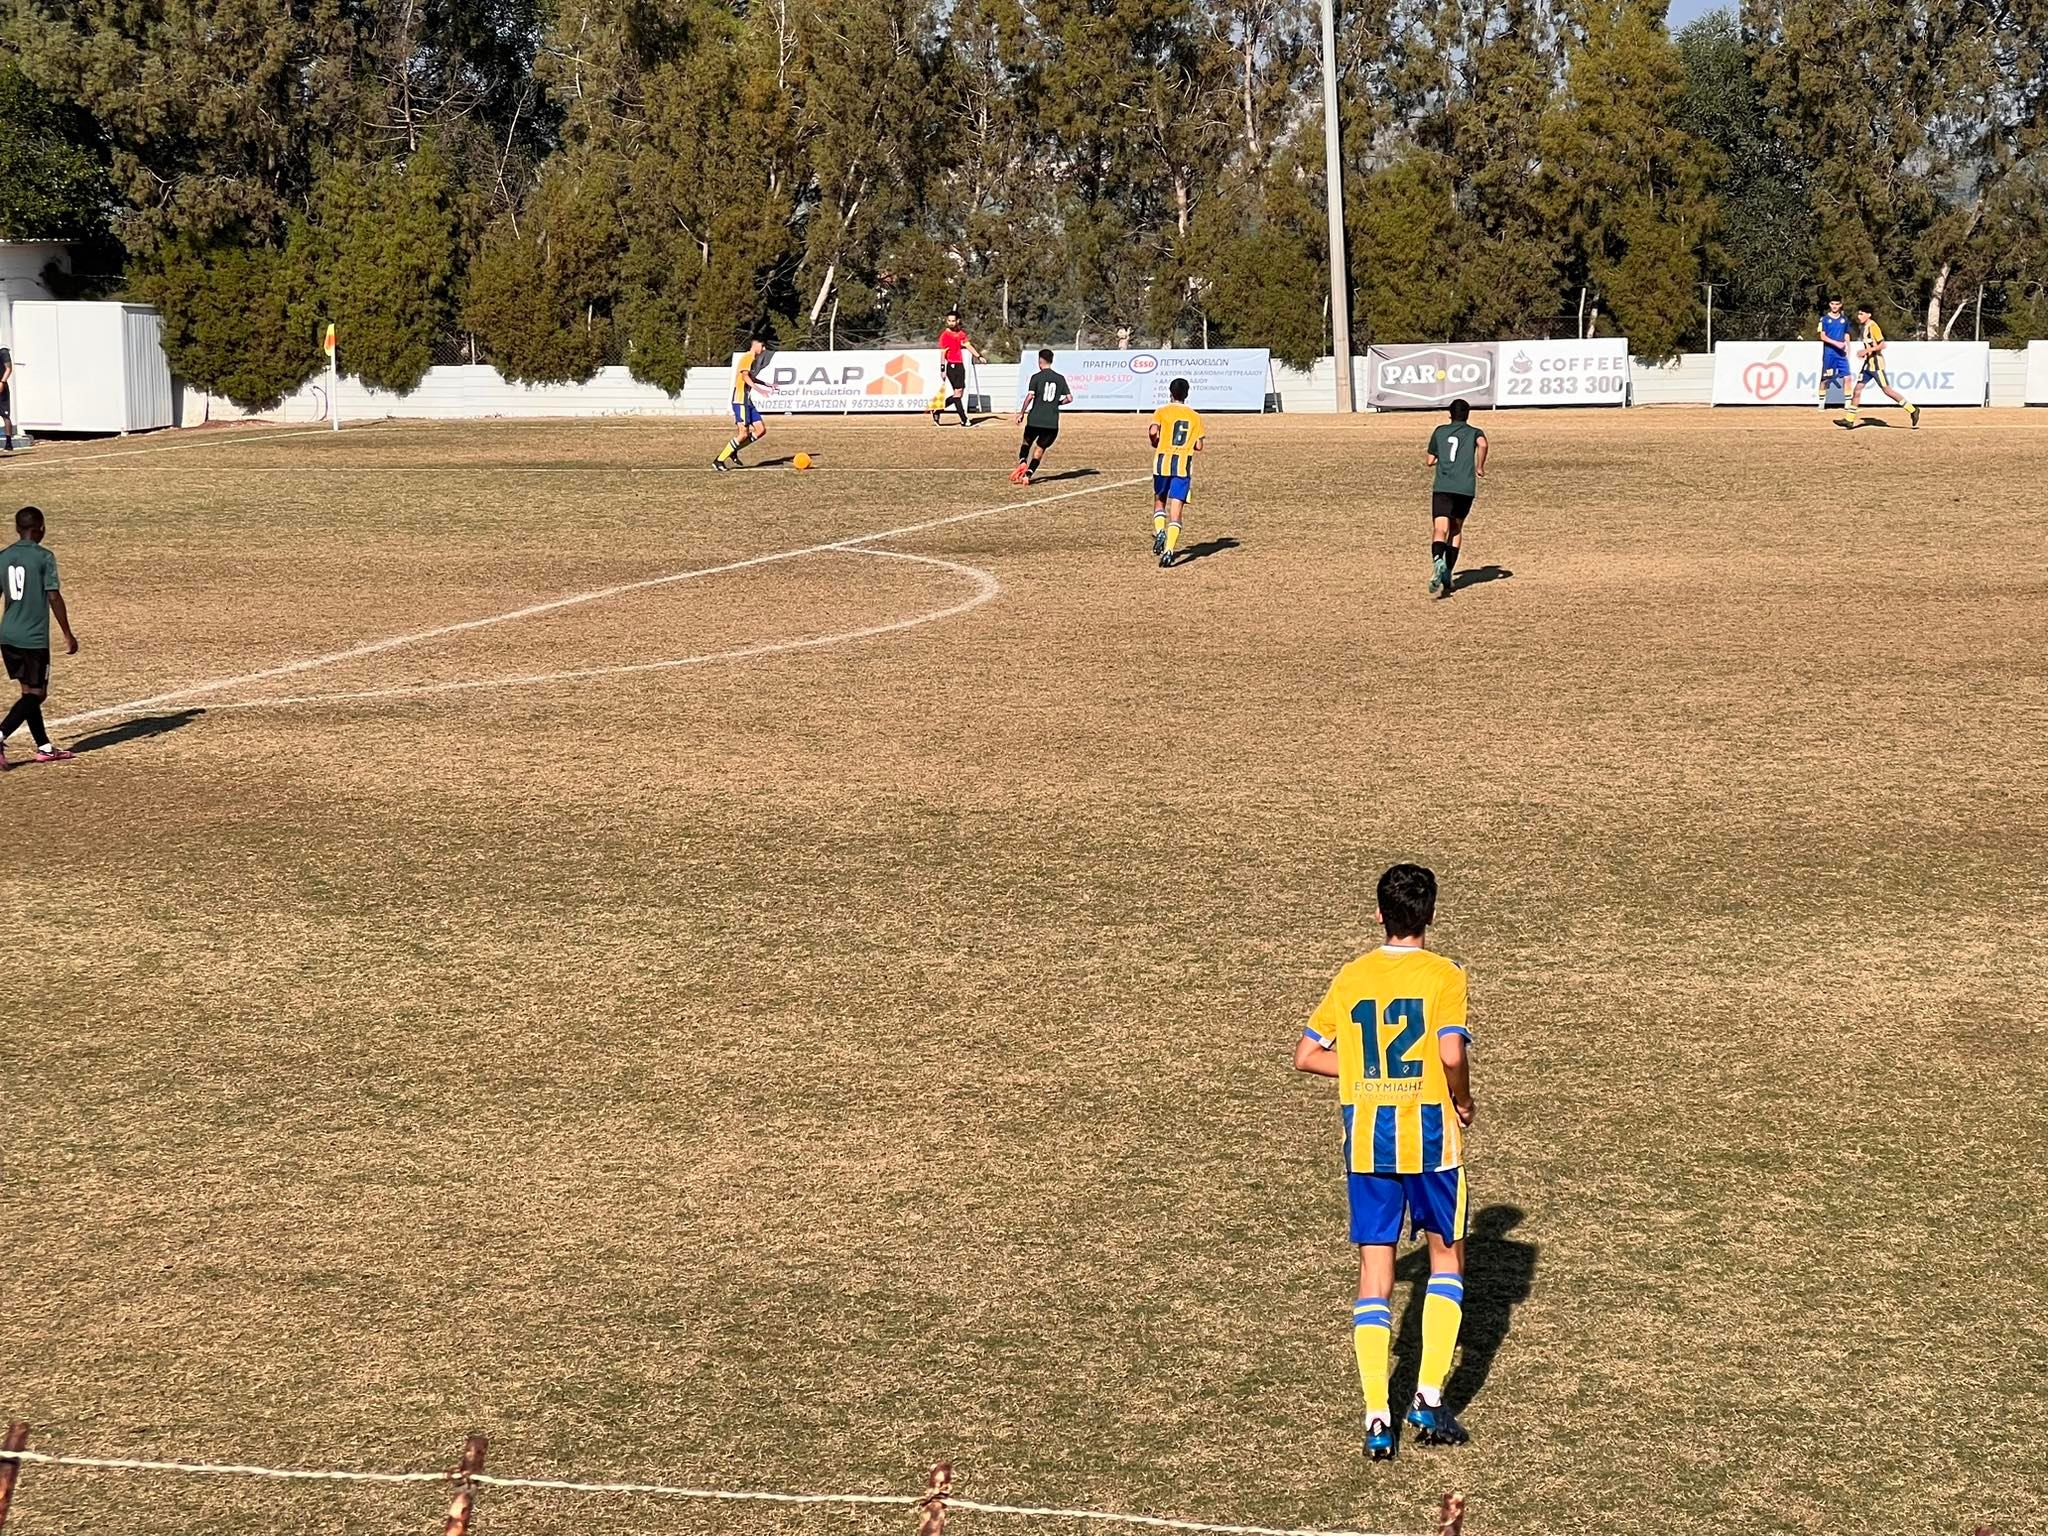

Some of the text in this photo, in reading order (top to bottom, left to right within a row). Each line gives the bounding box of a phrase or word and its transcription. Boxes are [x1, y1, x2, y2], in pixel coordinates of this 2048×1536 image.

[1082, 360, 1128, 369] ΠΡΑΤΗΡΙΟ
[1539, 357, 1624, 372] COFFEE
[773, 366, 864, 385] D.A.P
[1507, 375, 1624, 395] 22 833 300
[802, 387, 861, 396] Insulation
[1043, 381, 1057, 402] 10
[896, 399, 904, 408] &
[1171, 420, 1189, 446] 6
[1447, 436, 1458, 462] 7
[1350, 998, 1426, 1079] 12
